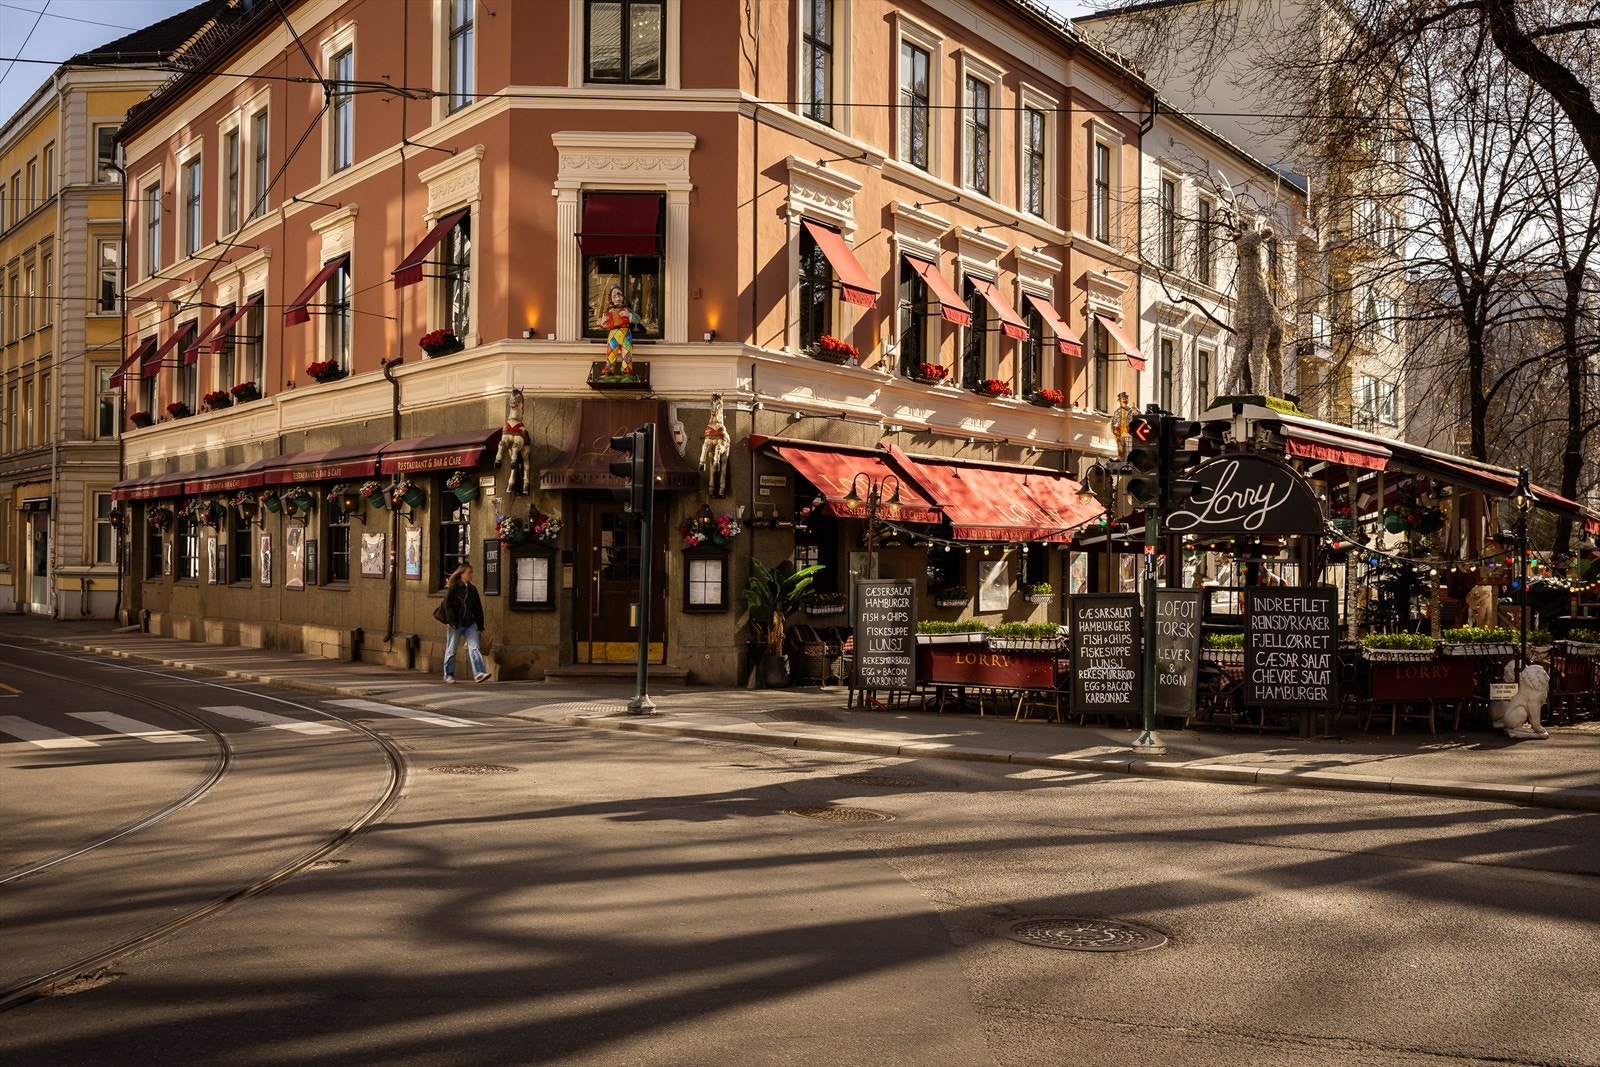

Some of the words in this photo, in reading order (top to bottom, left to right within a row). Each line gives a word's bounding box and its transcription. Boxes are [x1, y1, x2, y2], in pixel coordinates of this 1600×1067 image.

[397, 460, 428, 471] RESTAURANT
[433, 458, 443, 467] BAR
[865, 598, 910, 608] HAMBURGER
[1157, 600, 1197, 618] LOFOT
[1253, 597, 1329, 613] INDREFILET
[862, 612, 879, 623] FISH
[887, 611, 909, 622] CHIPS
[866, 626, 909, 636] FISKESUPPE
[1079, 620, 1131, 632] HAMBURGER
[1156, 621, 1195, 638] TORSK
[869, 637, 903, 651] LUNSJ
[1083, 634, 1103, 645] FISH
[1108, 633, 1133, 644] CHIPS
[1252, 633, 1330, 649] FJELLØRRET
[1080, 646, 1131, 658] FISKESUPPE
[1158, 648, 1192, 661] LEVER
[955, 652, 1010, 667] LORRY
[1090, 658, 1124, 669] LUNSJ
[1255, 651, 1299, 667] CÆSAR
[1301, 653, 1331, 669] SALAT
[861, 667, 875, 676] EGG
[882, 667, 908, 676] BACON
[1168, 663, 1175, 673] &
[1395, 665, 1450, 679] LORRY
[866, 676, 907, 686] KARBONADE
[1159, 674, 1187, 686] ROGN
[1252, 668, 1298, 684] CHEVRE
[1300, 670, 1331, 685] SALAT
[1084, 681, 1100, 691] EGG
[1106, 681, 1133, 691] BACON
[1085, 692, 1130, 704] KARBONADE
[1255, 685, 1328, 700] HAMBURGER
